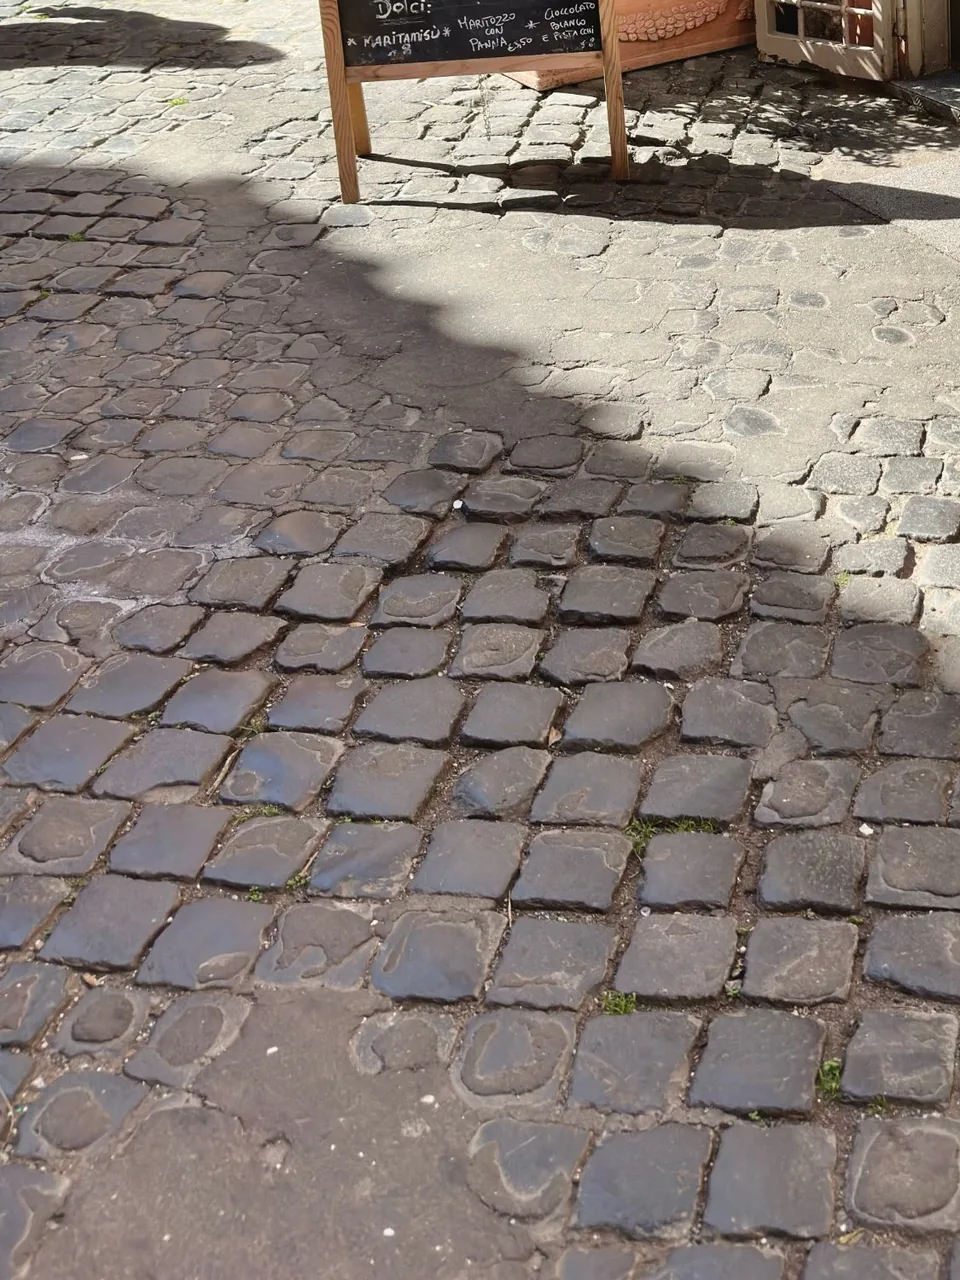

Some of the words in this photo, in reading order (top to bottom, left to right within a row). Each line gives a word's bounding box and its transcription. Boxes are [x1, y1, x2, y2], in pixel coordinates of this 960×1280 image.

[457, 12, 516, 31] MARITOZZO
[550, 18, 586, 31] BIANCO
[485, 25, 504, 36] CON
[469, 36, 508, 52] PANNA
